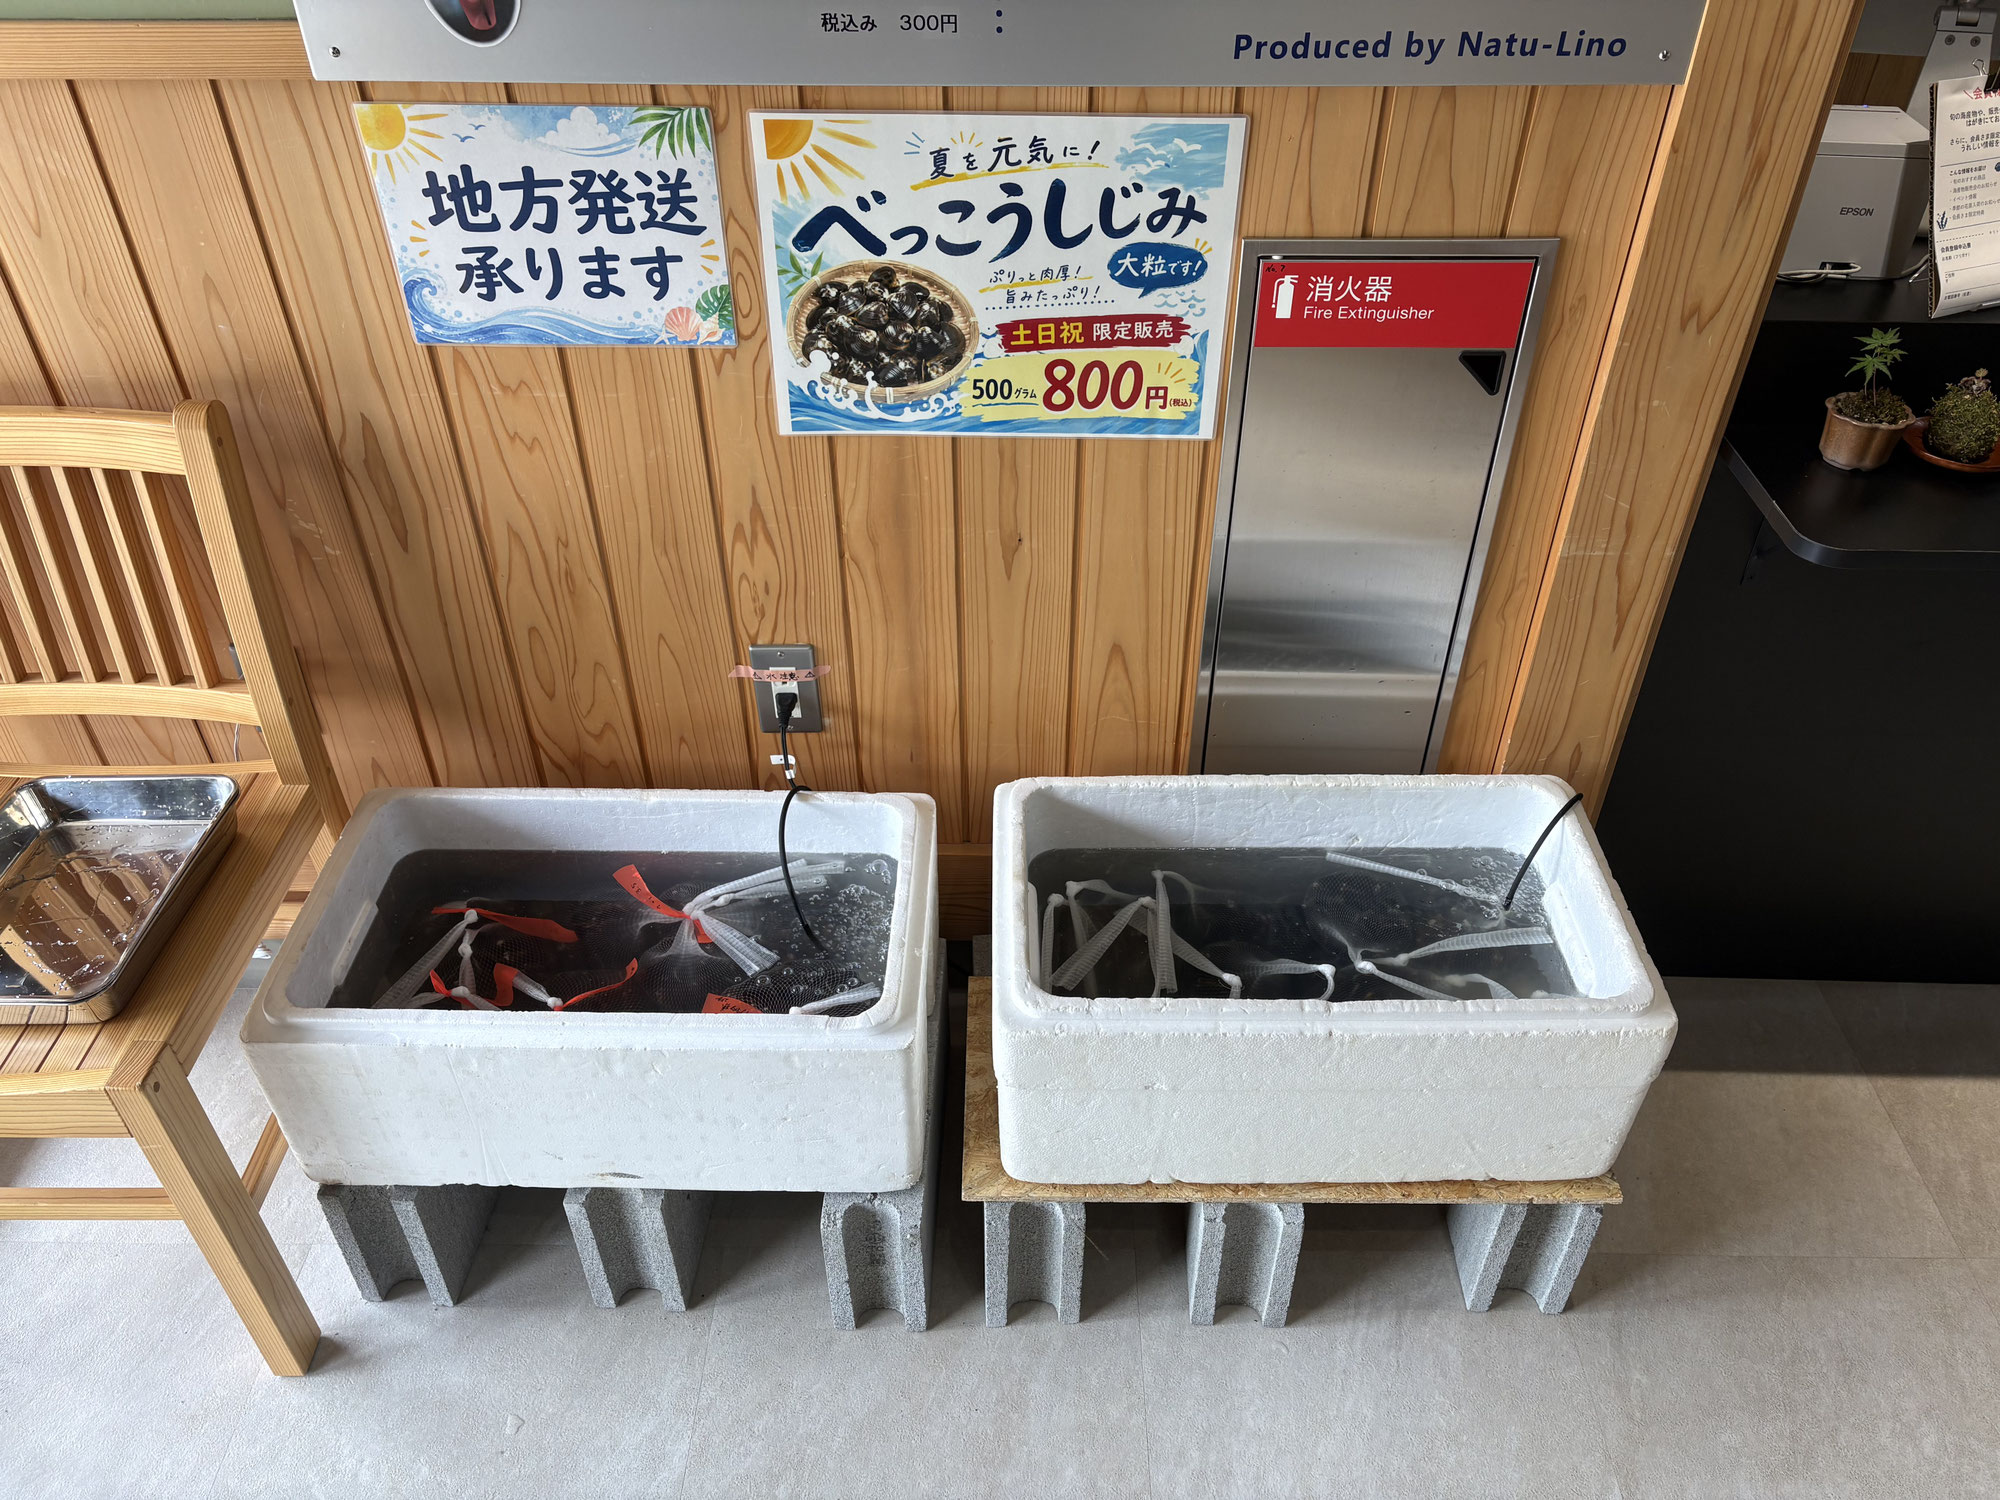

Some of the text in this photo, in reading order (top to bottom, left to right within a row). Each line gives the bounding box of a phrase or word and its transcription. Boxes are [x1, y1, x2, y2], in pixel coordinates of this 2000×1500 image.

[821, 13, 958, 33] 税込み 300円
[1233, 30, 1627, 64] Produced by Natu-Lino
[929, 135, 1100, 180] 夏を元気に!
[421, 164, 707, 235] 地方発送
[1840, 206, 1874, 217] EPSON
[792, 178, 1207, 263] べっこうしじみ
[456, 246, 683, 302] 承ります
[989, 264, 1082, 284] ぷりっと肉厚!
[1114, 252, 1202, 278] 大粒です!
[1006, 285, 1100, 304] 旨みたっぷり!
[1306, 275, 1393, 303] 消火器
[1303, 306, 1435, 323] Fire Extinguisher
[1010, 321, 1174, 346] 土日祝 限定販売
